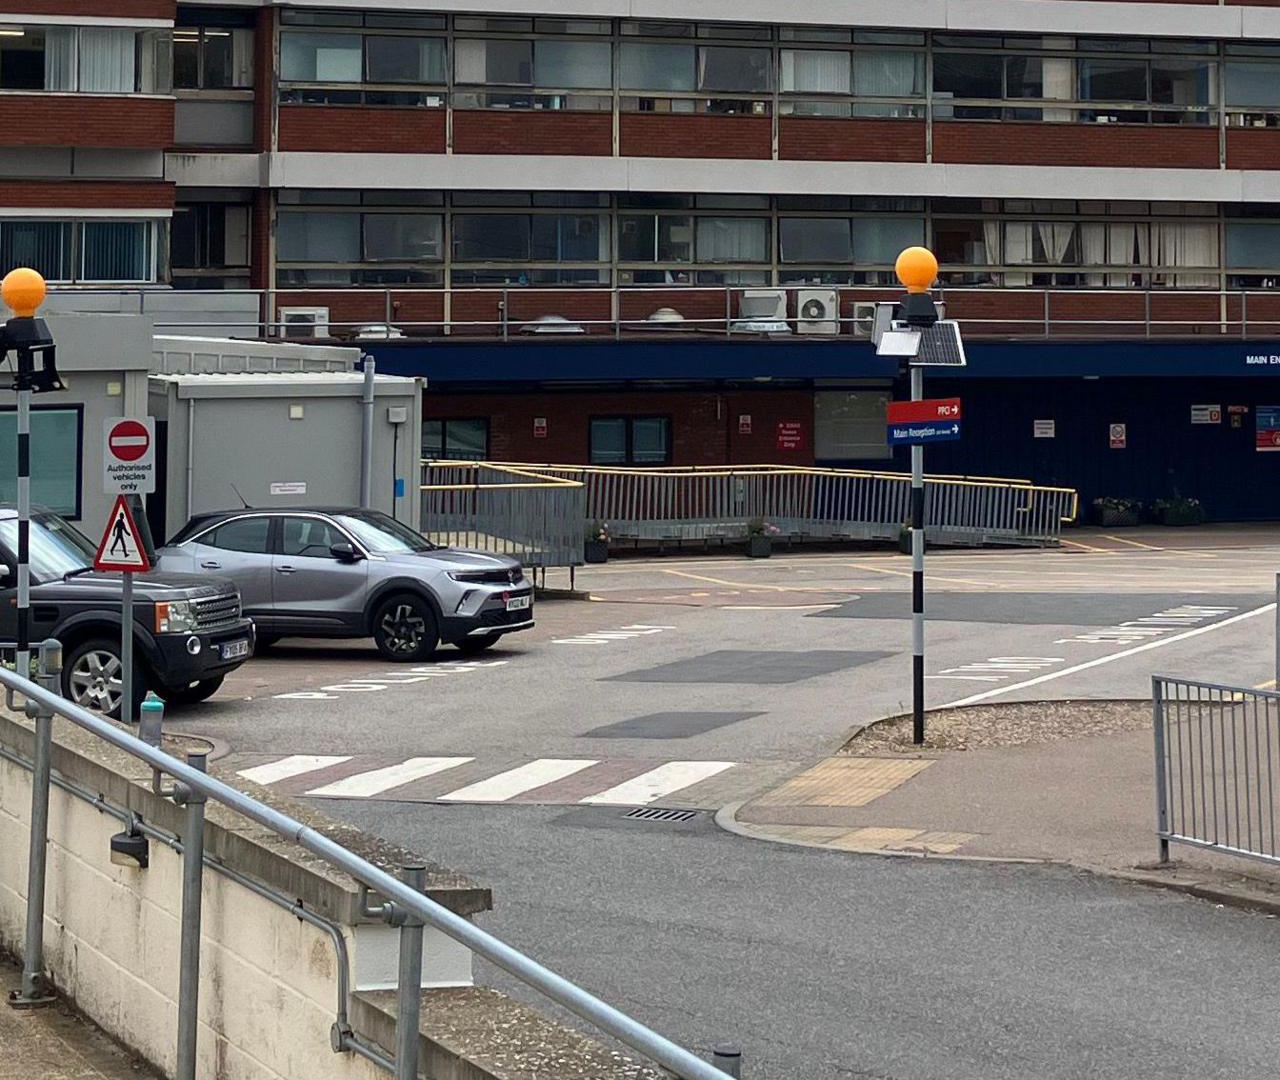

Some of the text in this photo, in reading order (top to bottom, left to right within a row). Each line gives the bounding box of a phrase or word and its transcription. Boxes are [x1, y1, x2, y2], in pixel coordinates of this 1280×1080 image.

[1246, 356, 1267, 364] MAIN
[893, 429, 908, 438] Main
[909, 427, 935, 438] Reception
[107, 464, 152, 473] Authorised
[112, 473, 146, 481] vehicles
[120, 482, 138, 491] only
